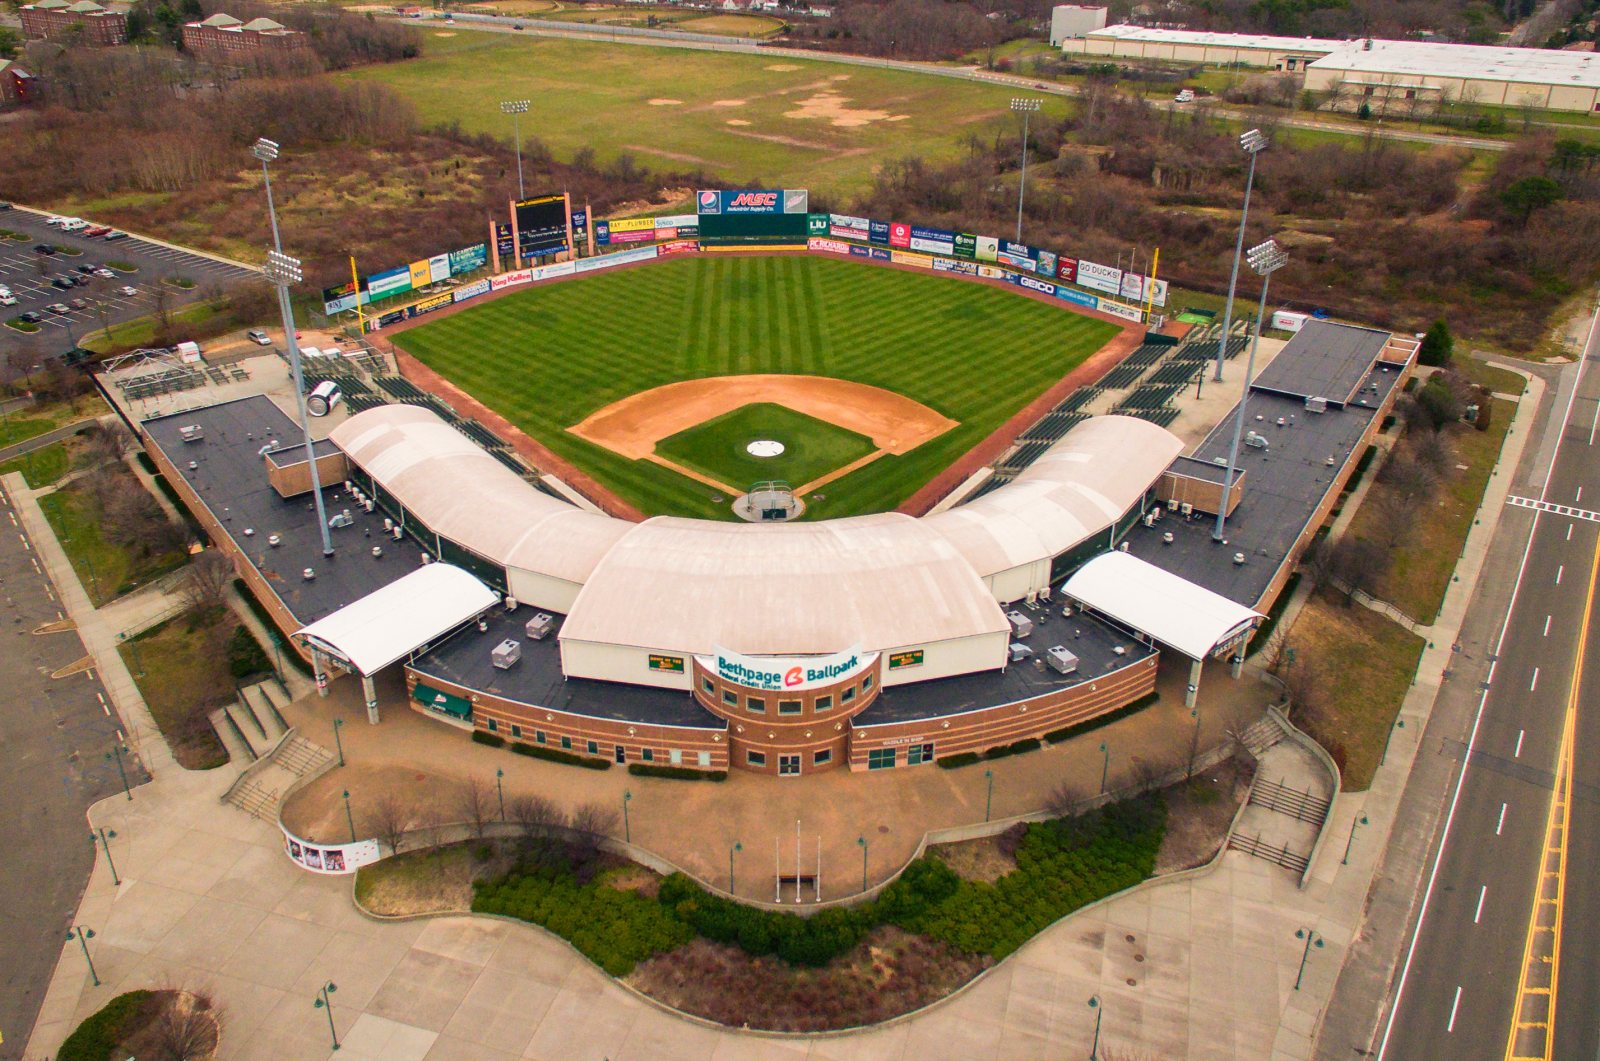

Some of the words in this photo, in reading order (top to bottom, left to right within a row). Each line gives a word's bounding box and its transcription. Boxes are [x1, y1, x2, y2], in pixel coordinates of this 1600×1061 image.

[731, 193, 777, 206] MSC
[627, 219, 654, 228] PLUMBER
[810, 219, 826, 229] LIU
[1080, 263, 1091, 272] GO
[1092, 266, 1120, 279] DUCKS!
[492, 279, 507, 288] King
[508, 273, 531, 283] Kullen
[1020, 277, 1055, 294] GEICO
[718, 656, 781, 684] Bethpage
[807, 655, 858, 682] Ballpark
[718, 669, 739, 683] Federal
[740, 679, 760, 689] Credit
[761, 682, 782, 690] Union
